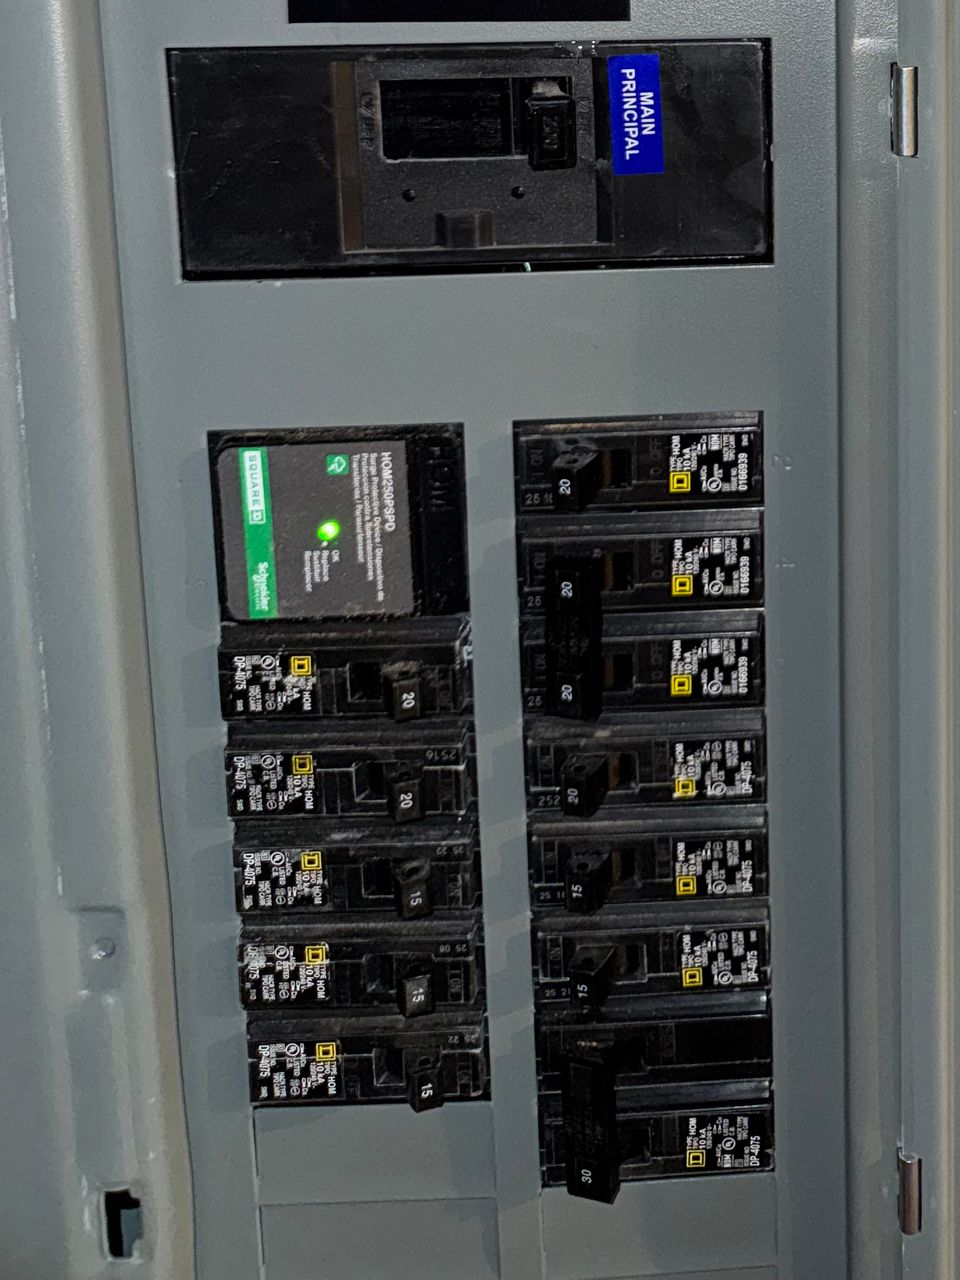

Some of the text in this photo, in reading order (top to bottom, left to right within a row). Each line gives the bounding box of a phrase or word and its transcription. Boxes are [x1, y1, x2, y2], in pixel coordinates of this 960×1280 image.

[621, 68, 639, 160] PRINCIPAL
[640, 91, 655, 136] MAIN
[672, 435, 681, 455] HOM
[249, 455, 260, 507] SQUARE
[738, 453, 747, 491] 0166939
[381, 452, 395, 532] HOM250PSPD
[559, 478, 571, 495] 20
[332, 549, 339, 563] OK
[674, 539, 683, 558] HOM
[740, 556, 749, 593] 0166939
[258, 562, 269, 611] Schneider
[561, 581, 573, 598] 20
[234, 656, 246, 690] DP-4075
[739, 657, 748, 693] 0166939
[402, 692, 415, 710] 20
[561, 684, 573, 701] 20
[234, 756, 246, 790] DP-4075
[305, 790, 313, 809] HOM
[401, 792, 412, 808] 20
[568, 788, 578, 804] 20
[244, 853, 256, 885] DP-4075
[410, 890, 421, 906] 15
[572, 884, 582, 898] 15
[748, 950, 758, 982] DP-4075
[412, 988, 424, 1003] 15
[578, 984, 588, 998] 15
[259, 1045, 270, 1077] DP-4075
[328, 1075, 336, 1094] HOM
[421, 1083, 433, 1098] 15
[750, 1135, 760, 1167] DP-4075
[582, 1170, 592, 1184] 30
